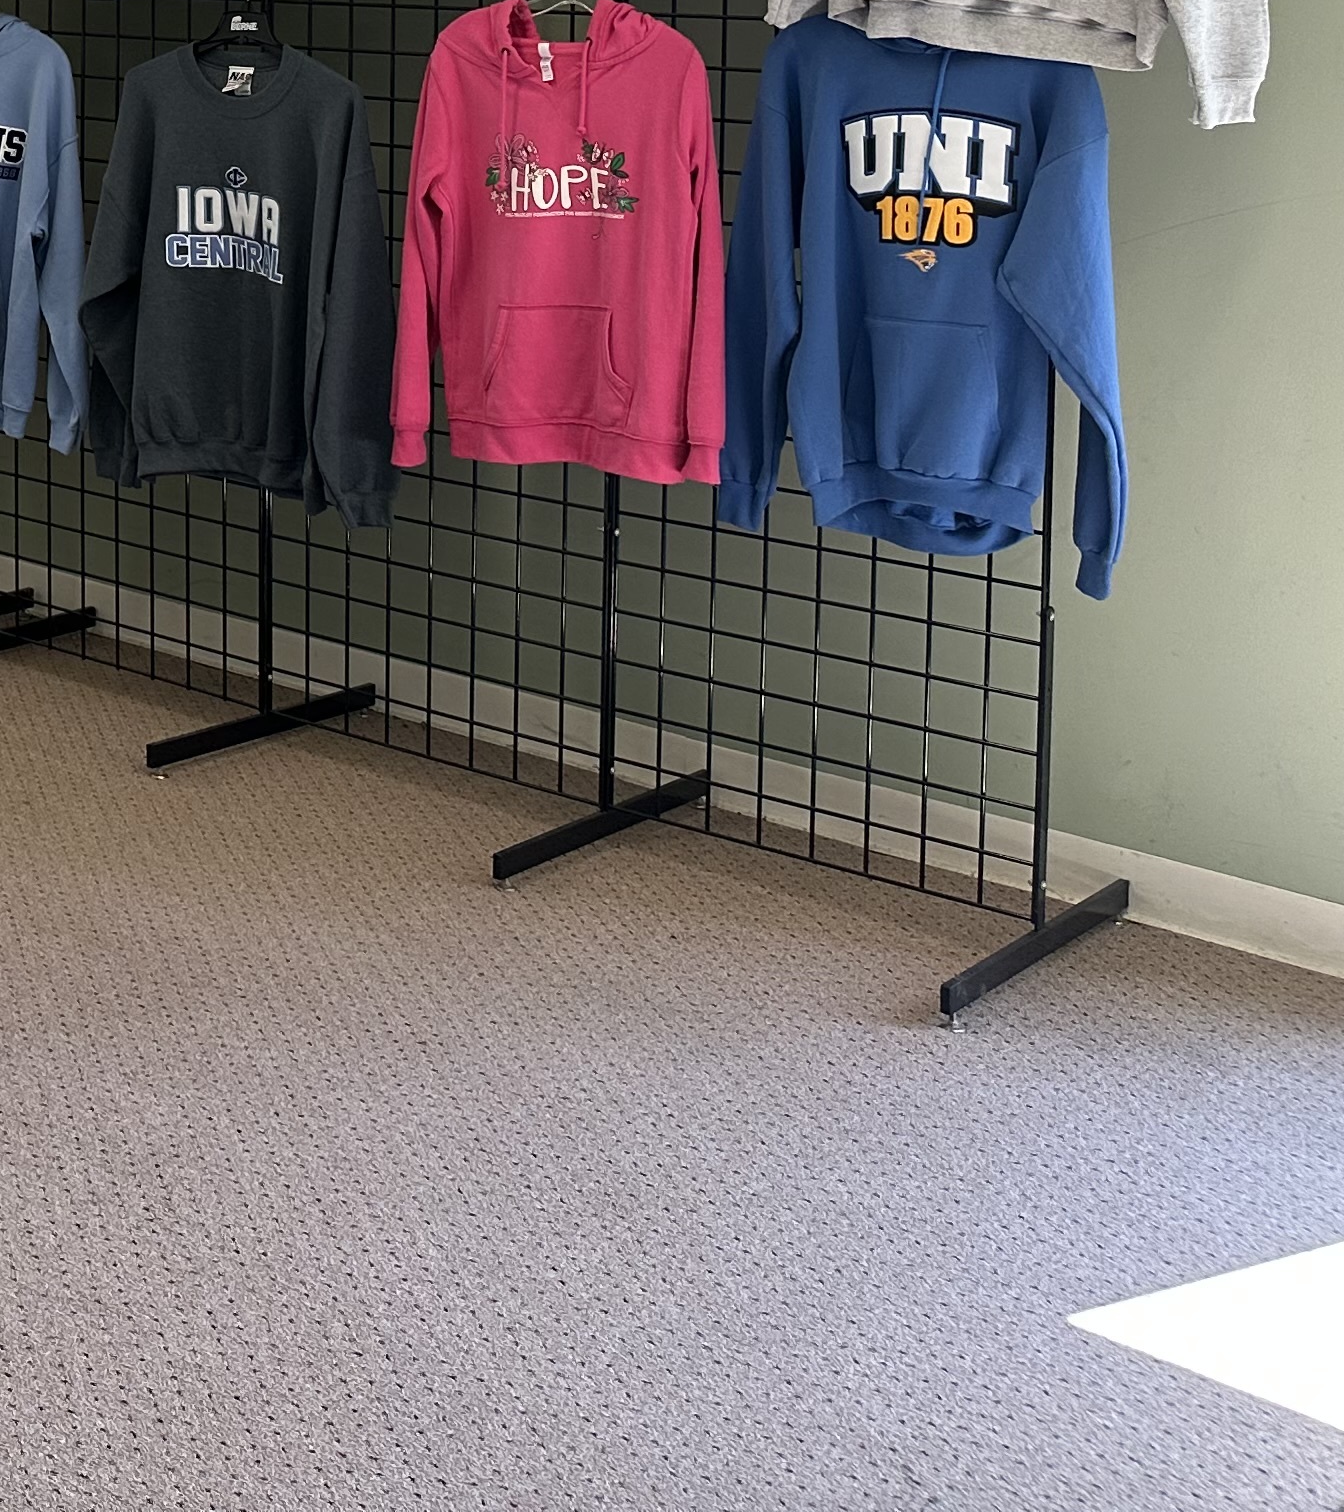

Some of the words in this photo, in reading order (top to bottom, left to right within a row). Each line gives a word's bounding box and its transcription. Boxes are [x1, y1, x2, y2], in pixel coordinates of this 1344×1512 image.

[841, 111, 1018, 205] UNI
[511, 163, 609, 211] HOPE
[176, 186, 280, 247] IOWA
[876, 195, 974, 245] 1876
[165, 234, 283, 284] CENTRAL
